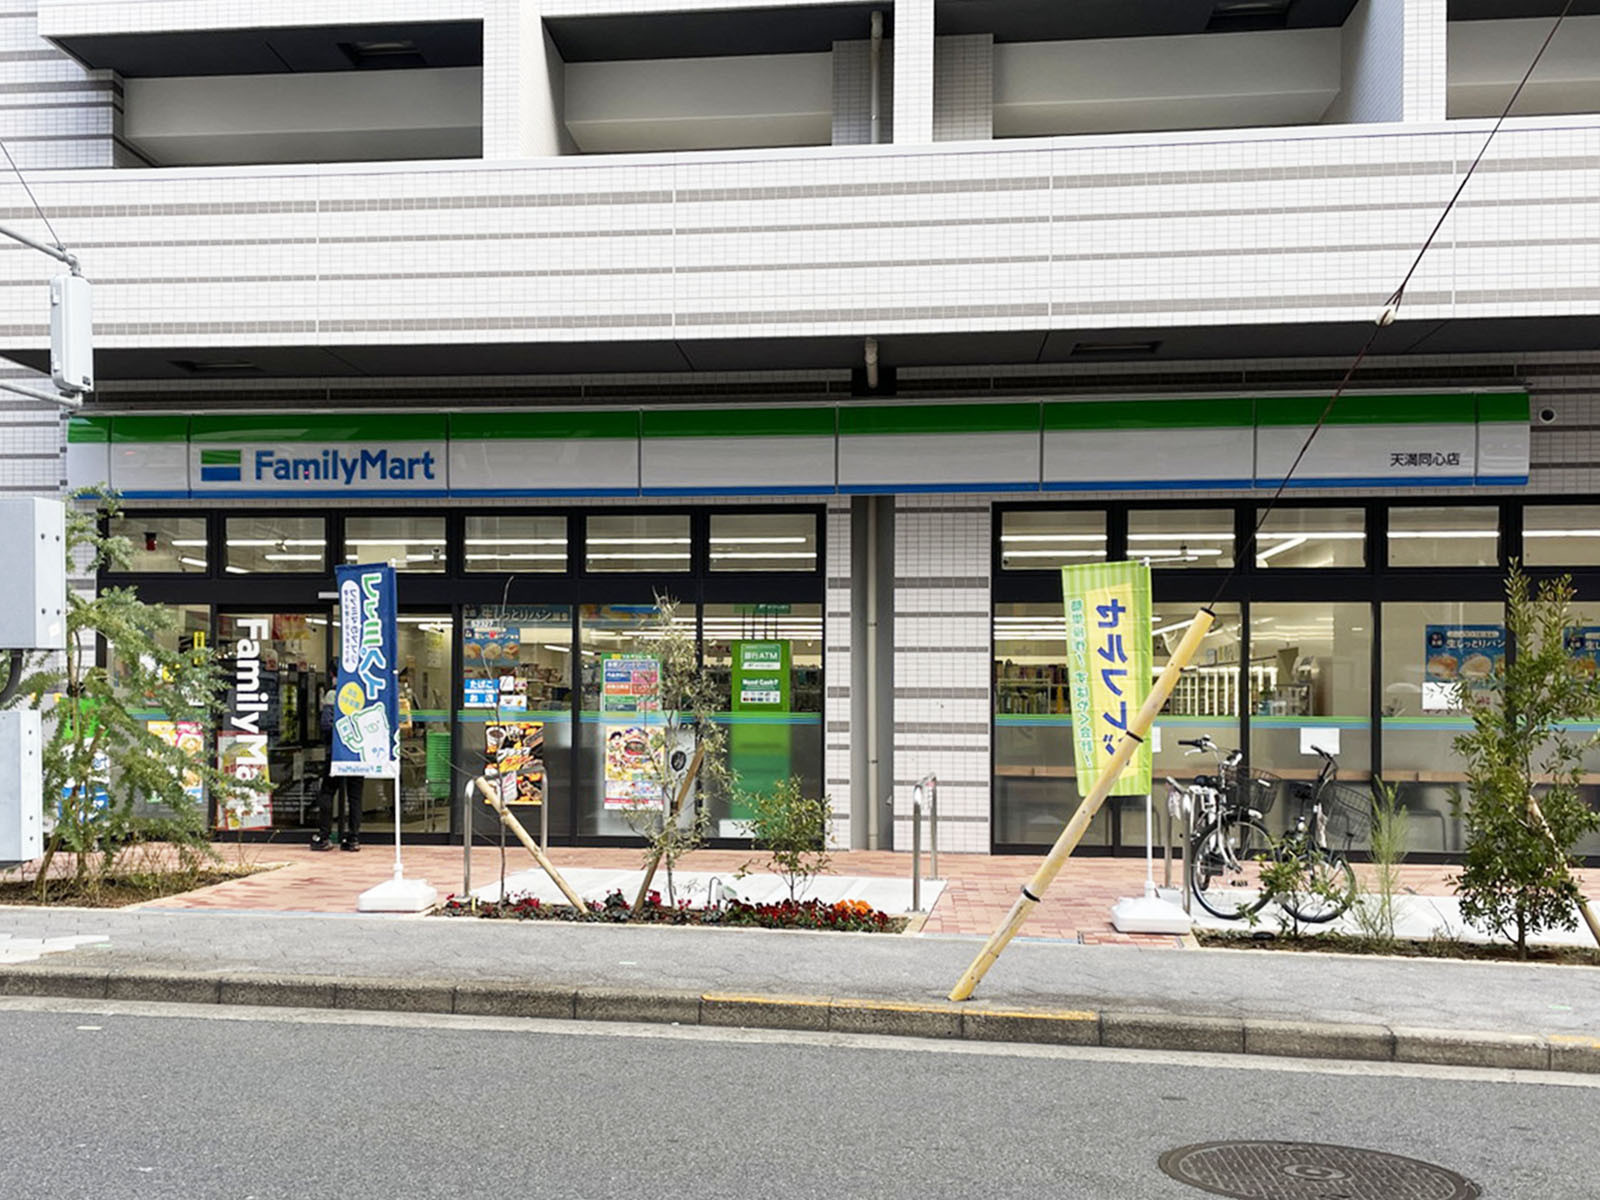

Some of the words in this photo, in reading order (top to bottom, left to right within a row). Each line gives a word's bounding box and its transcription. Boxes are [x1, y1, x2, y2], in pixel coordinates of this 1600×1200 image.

[255, 449, 435, 485] FamilyMart
[1390, 452, 1460, 467] 天満同心店
[470, 680, 493, 689] たばこ
[231, 618, 269, 821] FamilyMa
